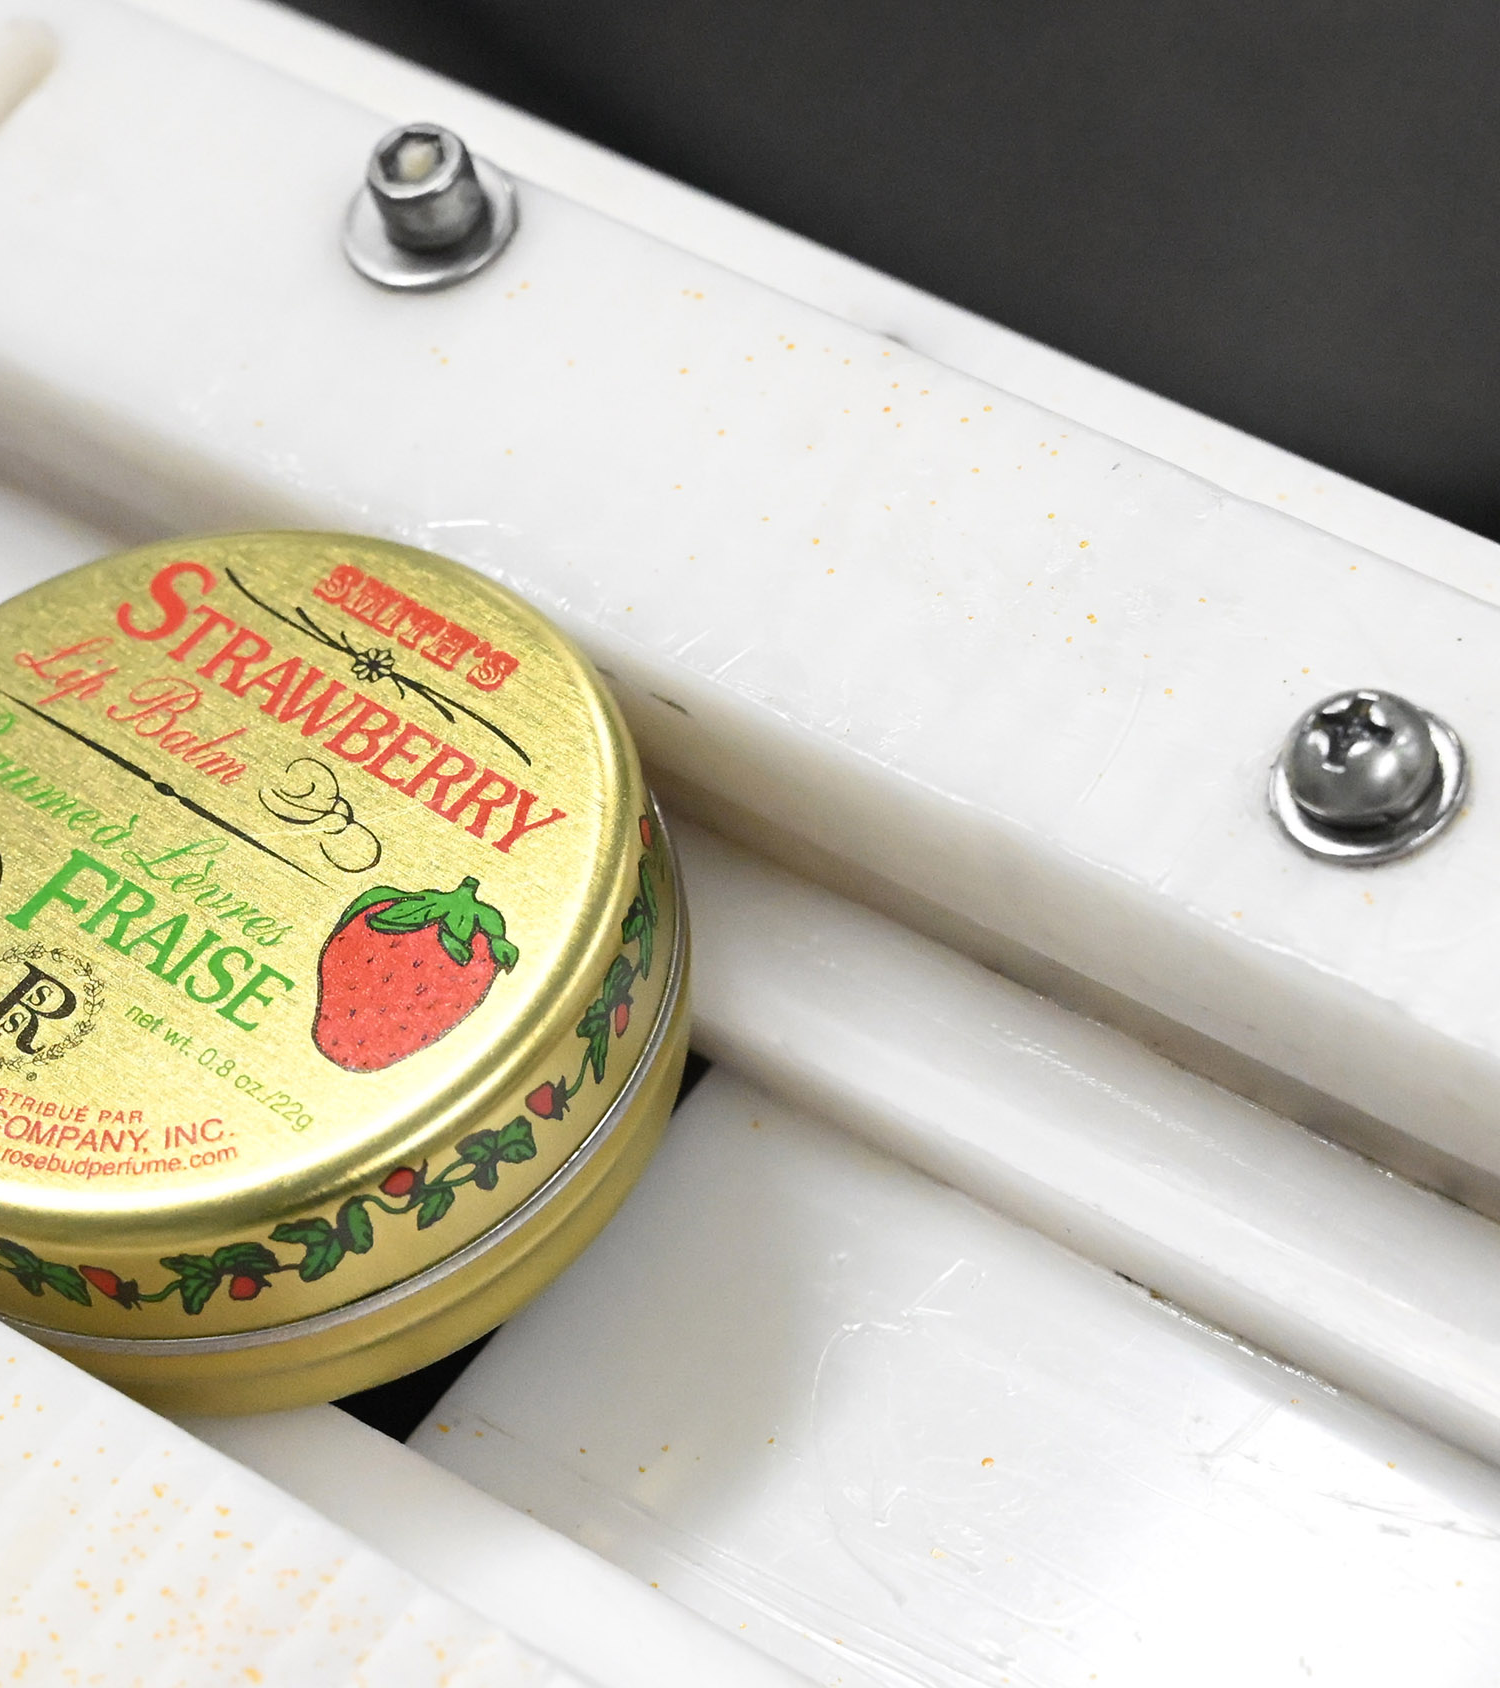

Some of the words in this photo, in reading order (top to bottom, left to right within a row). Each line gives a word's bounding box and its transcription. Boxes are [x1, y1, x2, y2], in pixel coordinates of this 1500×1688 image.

[313, 564, 519, 691] SMITH'S
[15, 637, 118, 705] Lip
[107, 676, 247, 785] Balm
[116, 561, 567, 854] STRAWBERRY
[5, 848, 294, 1031] FRAISE
[121, 837, 293, 946] Lèvres
[124, 1006, 164, 1033] net
[163, 1028, 193, 1056] wt.
[198, 1048, 236, 1077] 0.8
[98, 1110, 143, 1124] PAR
[164, 1118, 235, 1150] INC.
